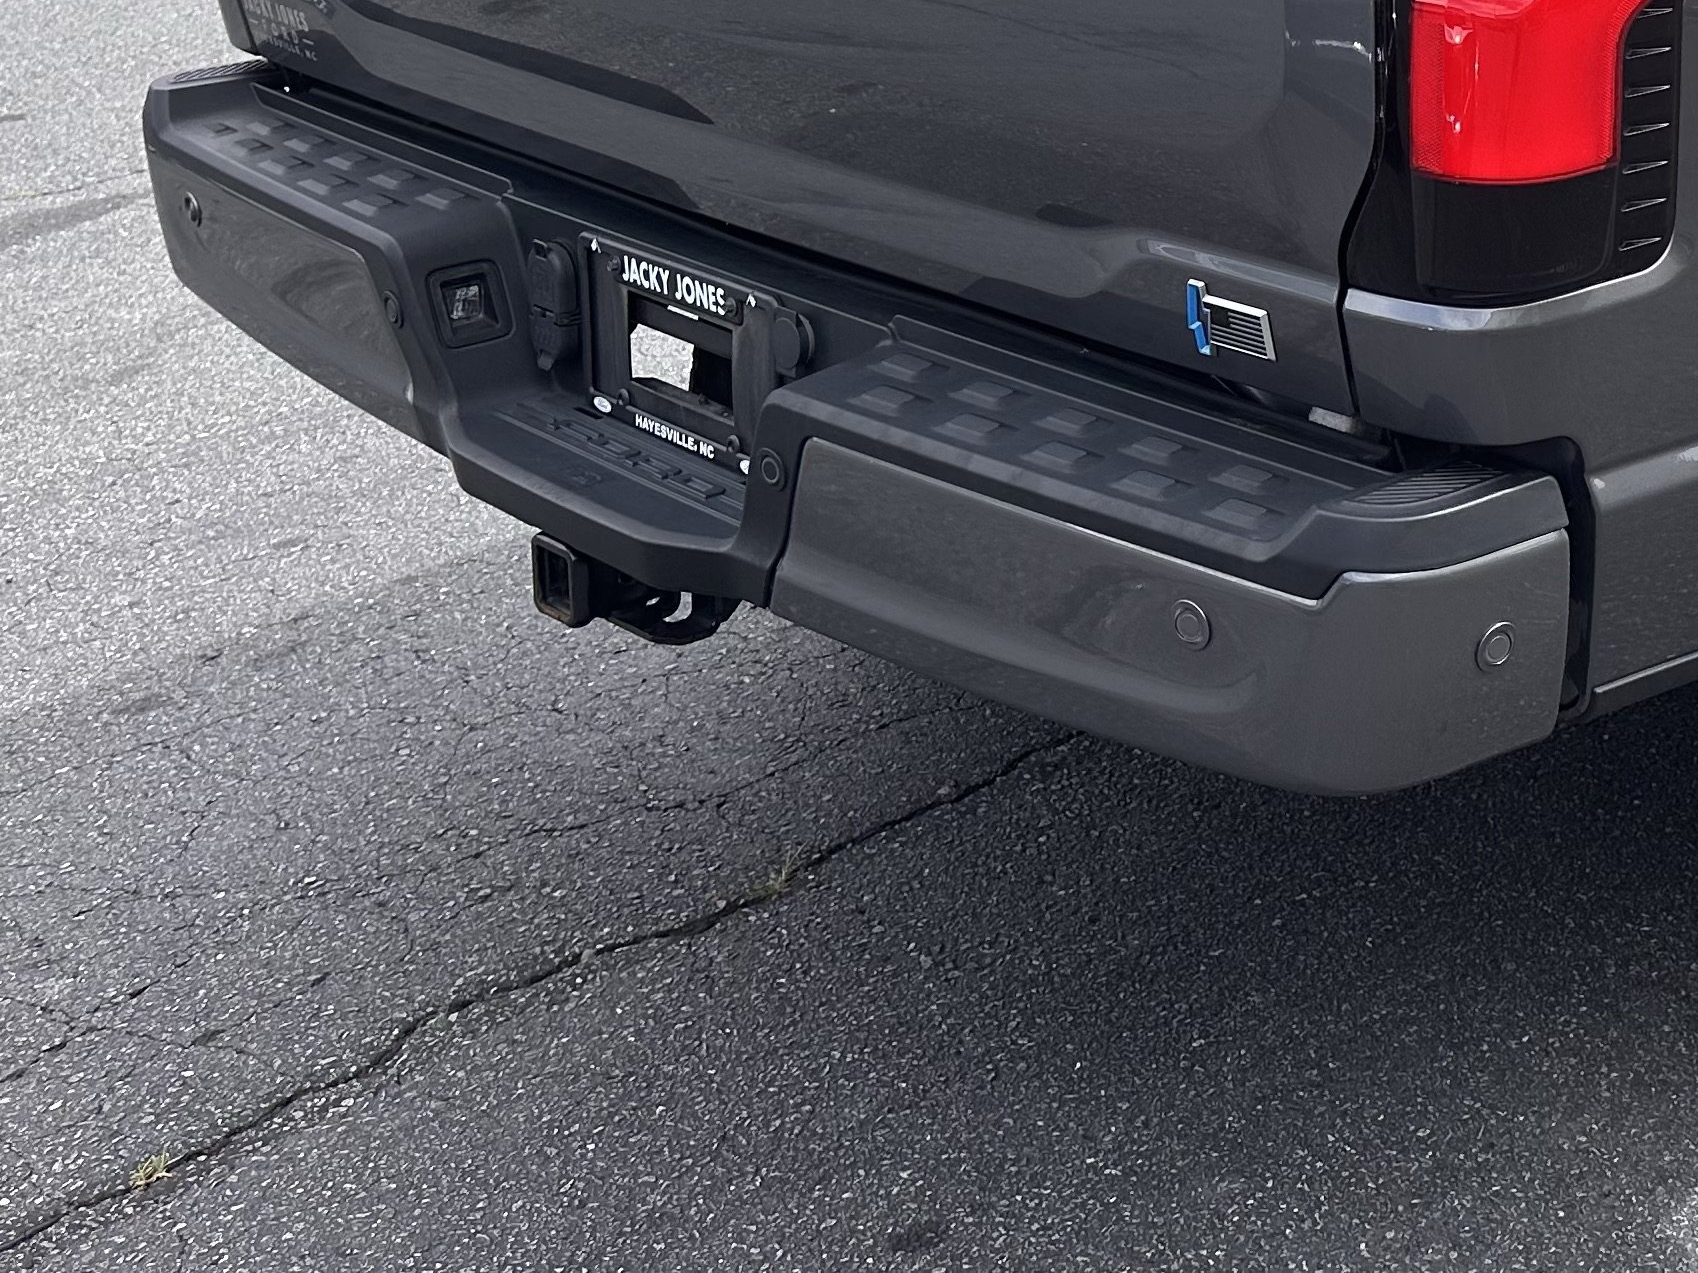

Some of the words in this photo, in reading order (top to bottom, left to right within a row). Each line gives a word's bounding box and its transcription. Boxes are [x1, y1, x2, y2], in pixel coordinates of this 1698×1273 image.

[275, 3, 309, 32] JONES
[622, 254, 670, 295] JACKY
[674, 273, 726, 316] JONES
[635, 413, 698, 452] HAYESVILLE,
[699, 440, 715, 459] NC
